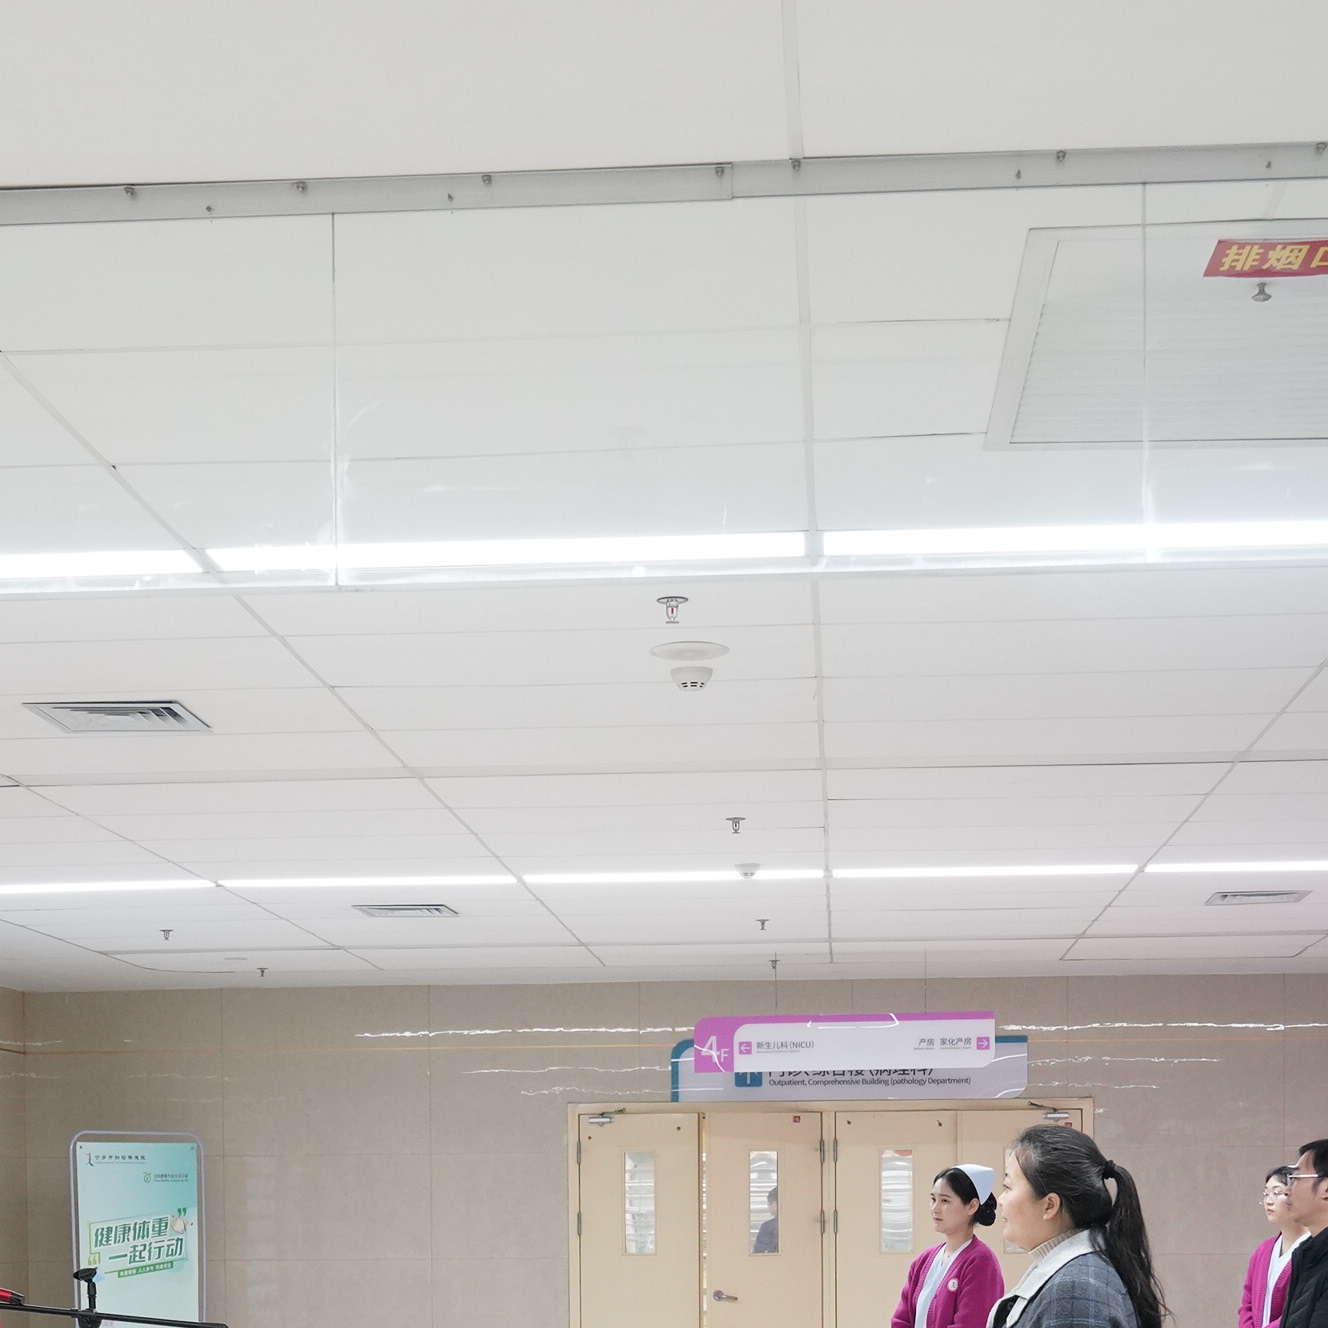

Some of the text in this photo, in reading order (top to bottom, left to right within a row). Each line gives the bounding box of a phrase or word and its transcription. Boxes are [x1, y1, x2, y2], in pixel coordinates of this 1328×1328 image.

[700, 1035, 729, 1063] 4F
[755, 1040, 815, 1050] 新生儿科(NICU)
[918, 1038, 935, 1046] 产房
[768, 1077, 971, 1087] Outpatient, Comprehensive Building (pathology Department)
[94, 1216, 169, 1248] 健康体重
[108, 1236, 184, 1265] 一起行动
